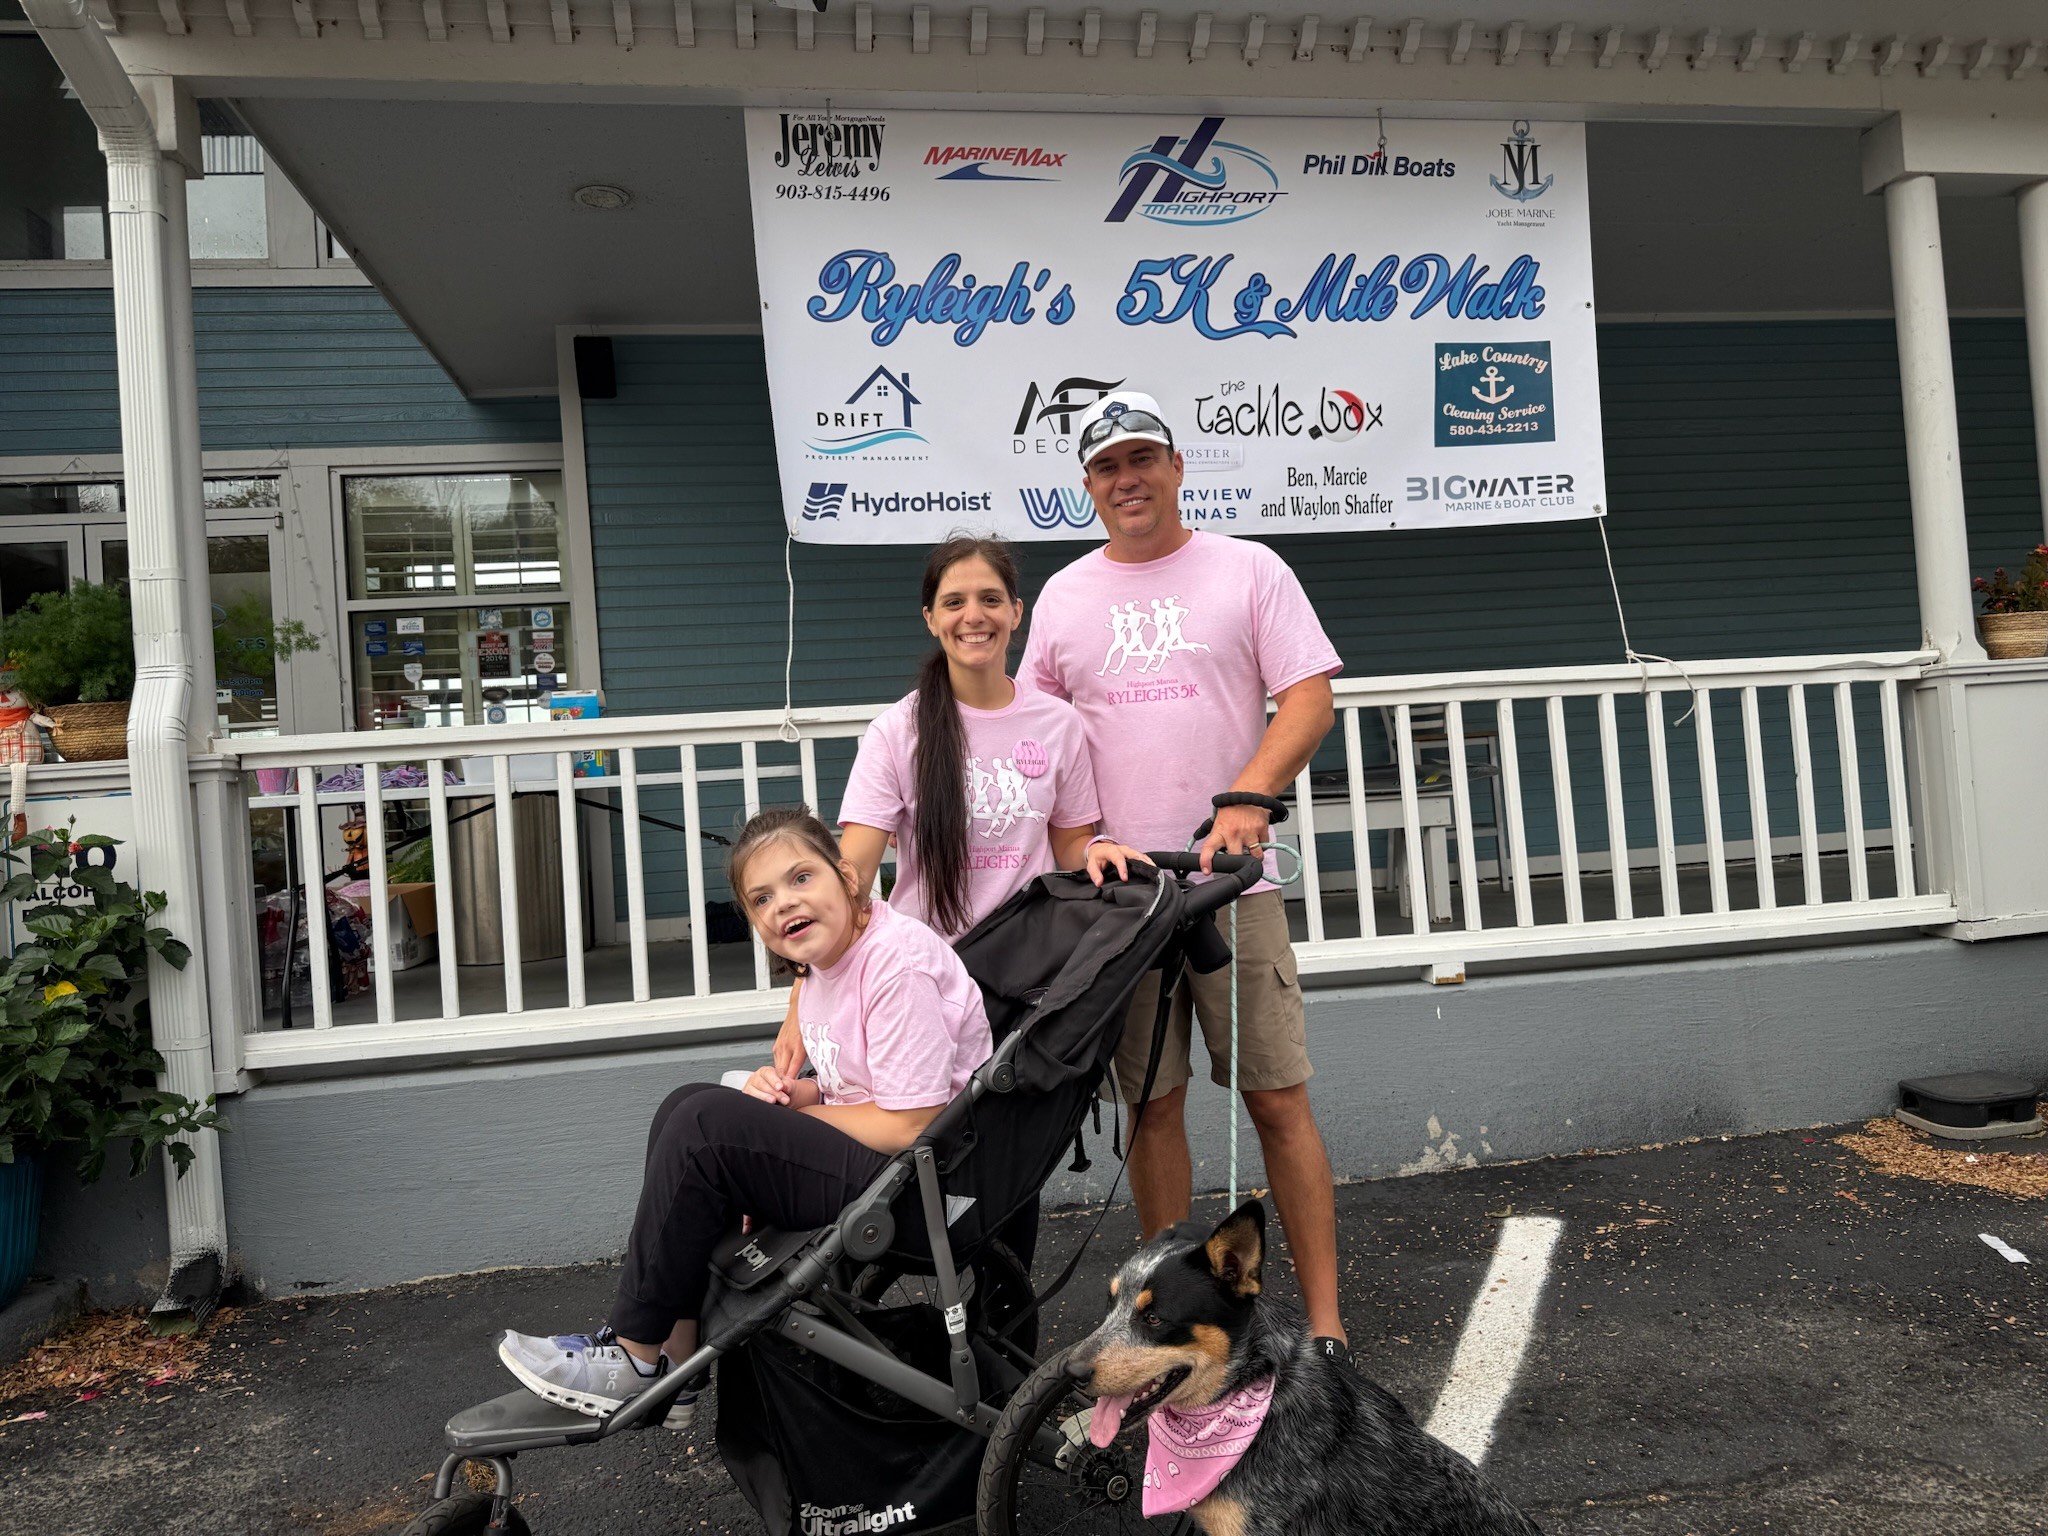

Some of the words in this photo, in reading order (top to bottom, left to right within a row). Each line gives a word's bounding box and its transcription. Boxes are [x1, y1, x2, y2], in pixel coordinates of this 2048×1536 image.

[774, 114, 886, 172] Jeremy
[798, 144, 861, 178] Lewis
[1303, 154, 1344, 175] Phil
[1352, 154, 1387, 176] Dill
[1393, 156, 1456, 177] Boats
[776, 184, 891, 202] 903-815-4496
[1142, 204, 1237, 216] MARINA
[1485, 208, 1514, 220] JOBE
[1516, 208, 1556, 220] MARINE
[807, 249, 1076, 347] Ryleigh's
[1116, 253, 1298, 340] 5K
[1234, 272, 1272, 325] &
[1439, 350, 1479, 372] Lake
[1482, 346, 1548, 374] Country
[1220, 380, 1246, 397] the
[816, 412, 883, 427] DRIFT
[1443, 402, 1495, 424] Cleaning
[1498, 403, 1546, 420] Service
[1449, 422, 1539, 436] 580-434-2213
[1287, 466, 1318, 490] Ben,
[1323, 466, 1368, 486] Marcie
[852, 491, 992, 516] HydroHoist
[1183, 488, 1252, 502] RVIEW
[1261, 496, 1286, 518] and
[1290, 495, 1341, 522] Waylon
[1344, 493, 1394, 516] Shaffer
[1446, 500, 1492, 512] MARINE
[1494, 500, 1502, 510] &
[1504, 498, 1536, 508] BOAT
[1540, 496, 1575, 507] CLUB
[1178, 507, 1238, 520] INAS
[1127, 680, 1155, 688] Highport
[1156, 678, 1178, 686] Marina
[1108, 686, 1179, 705] RYLEIGH'S
[1180, 684, 1200, 698] 5K
[26, 884, 96, 901] ALCOH
[800, 1502, 846, 1518] Zoom
[848, 1503, 864, 1514] 360
